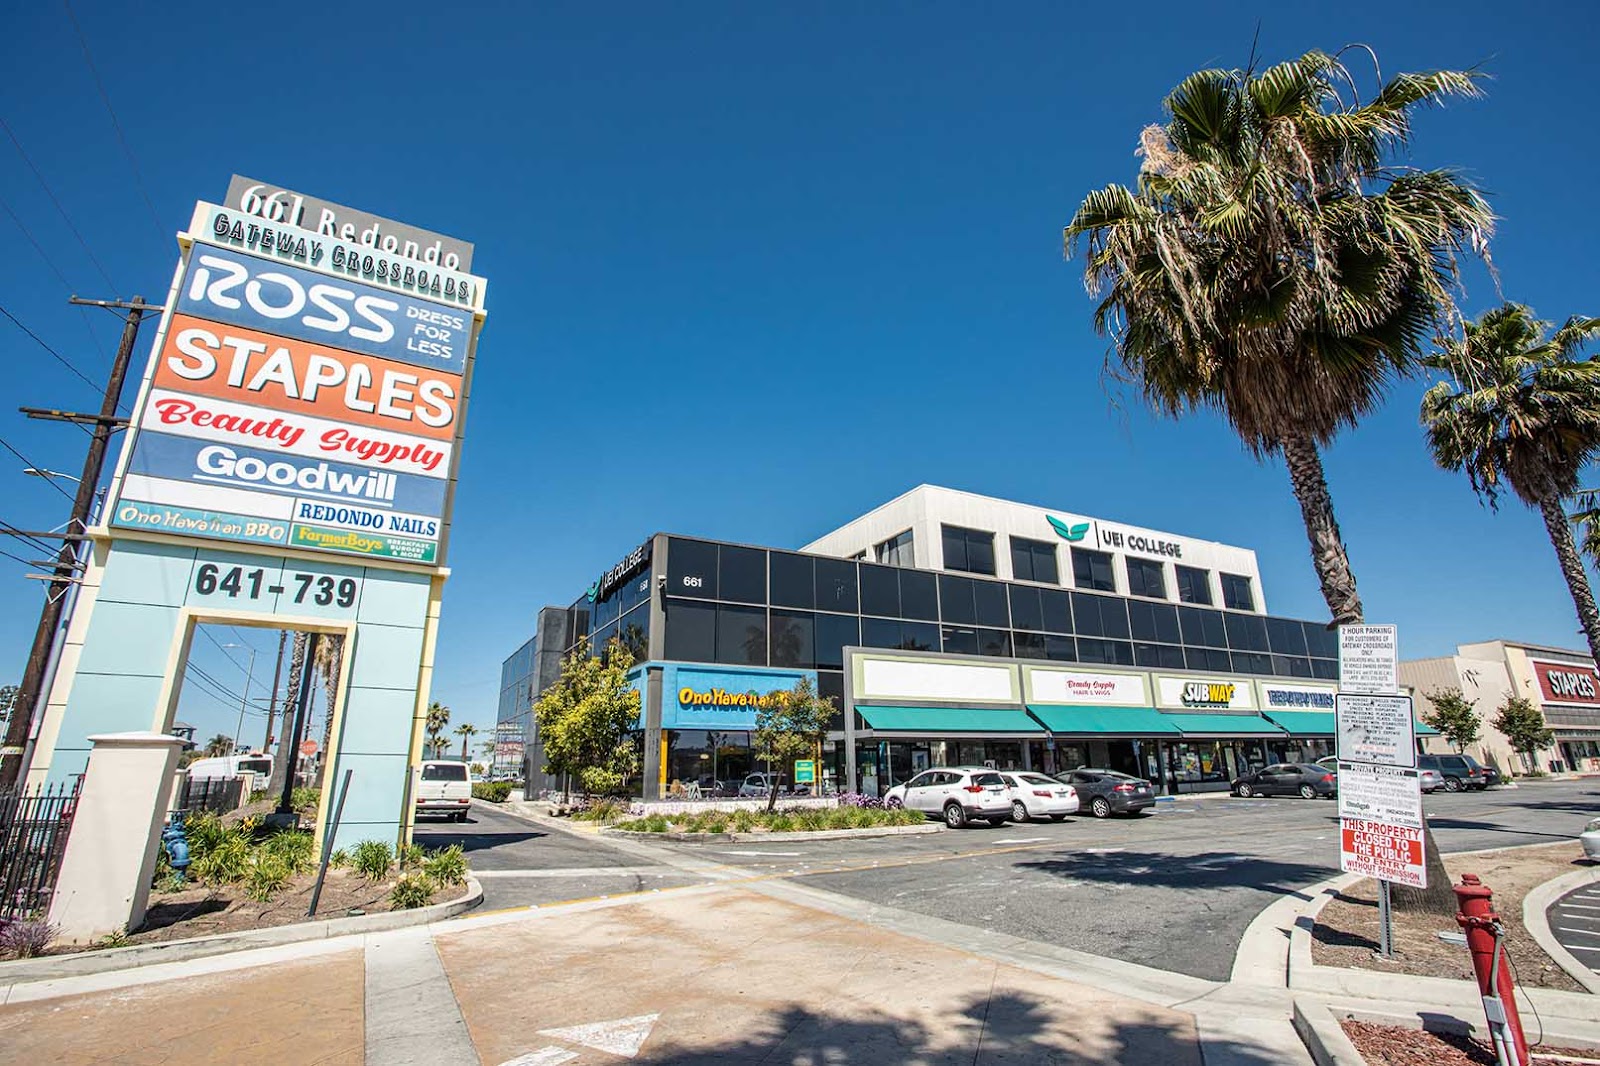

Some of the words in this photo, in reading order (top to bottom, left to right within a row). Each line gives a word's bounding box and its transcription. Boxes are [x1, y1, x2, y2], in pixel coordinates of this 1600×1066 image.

[240, 185, 304, 230] 661
[317, 208, 460, 271] Redondo
[213, 213, 323, 259] GATEWAY
[332, 245, 470, 299] CROSSROADS
[188, 255, 399, 343] ROSS
[406, 305, 464, 330] DRESS
[414, 323, 451, 342] FOR
[407, 337, 453, 359] LESS
[167, 329, 454, 428] STAPLES
[154, 399, 305, 447] Beauty
[319, 428, 444, 471] Supply
[196, 445, 397, 501] Goodwill
[119, 507, 161, 524] Ono
[163, 511, 242, 535] Hawaiian
[245, 523, 285, 540] BBQ
[299, 503, 384, 529] REDONDO
[389, 516, 437, 536] NAILS
[390, 545, 425, 554] BURGERS
[1102, 529, 1124, 547] UEI
[1128, 536, 1182, 558] COLLEGE
[400, 551, 423, 559] MORE
[603, 570, 616, 588] UEI
[614, 546, 643, 580] COLLEGE
[683, 576, 702, 588] 661
[1067, 680, 1091, 690] Beauty
[1093, 680, 1115, 690] Supply
[1185, 683, 1236, 703] SUBWAY
[1547, 670, 1595, 698] STAPLES
[679, 687, 712, 705] Ono
[1343, 818, 1364, 831] THIS
[1367, 822, 1420, 840] PROPERTY
[1352, 842, 1372, 855] THE
[1374, 845, 1411, 862] PUBLIC
[1354, 832, 1391, 849] CLOSED
[1395, 840, 1409, 851] TO
[1347, 860, 1376, 872] WITHOUT
[1378, 866, 1420, 880] PERMISSION
[1374, 858, 1406, 870] ENTRY
